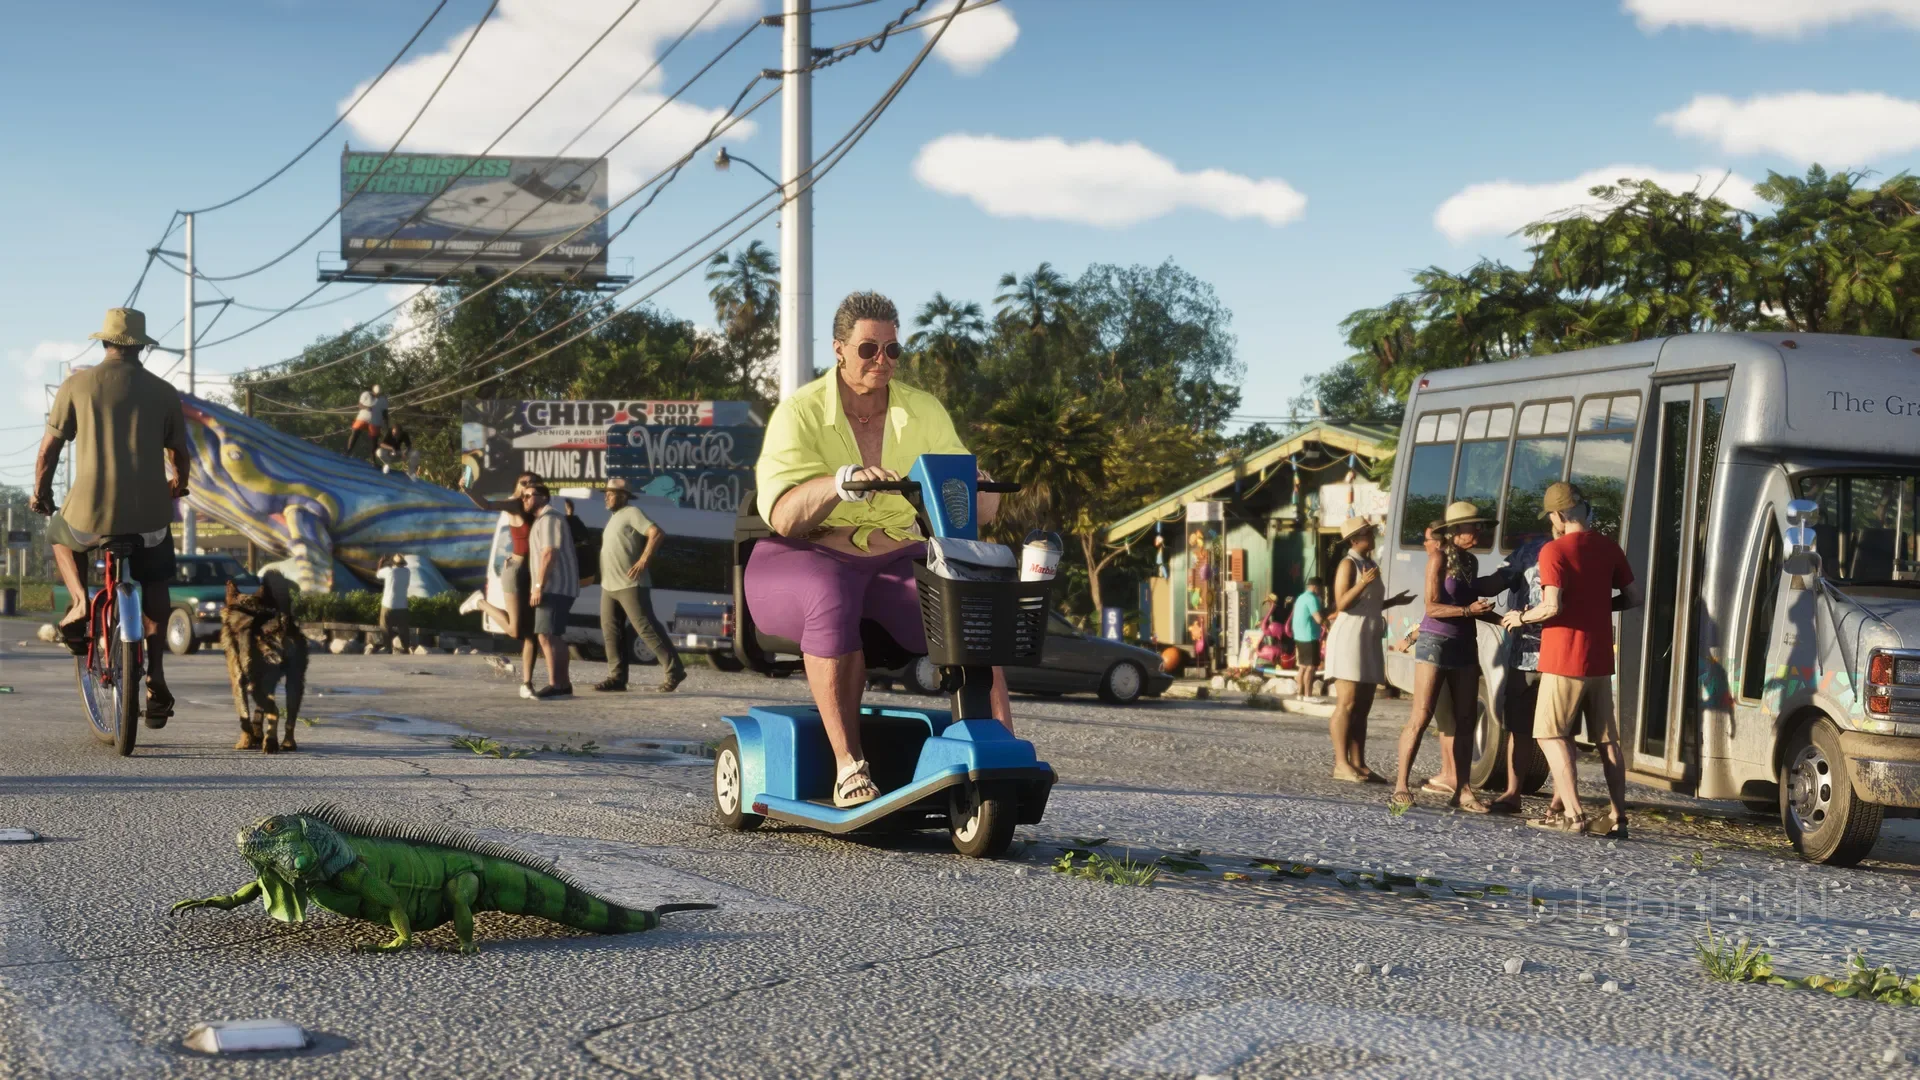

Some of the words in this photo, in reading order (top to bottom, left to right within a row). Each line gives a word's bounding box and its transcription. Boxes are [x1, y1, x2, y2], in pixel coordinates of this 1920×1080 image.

[410, 157, 511, 177] BUSINESS
[654, 403, 699, 415] BODY
[1826, 391, 1875, 413] The
[527, 402, 648, 426] CHIP'S
[654, 415, 699, 426] SHOP
[524, 450, 580, 478] HAVING
[585, 450, 596, 478] A
[675, 471, 740, 511] Whal
[1107, 610, 1118, 639] SA
